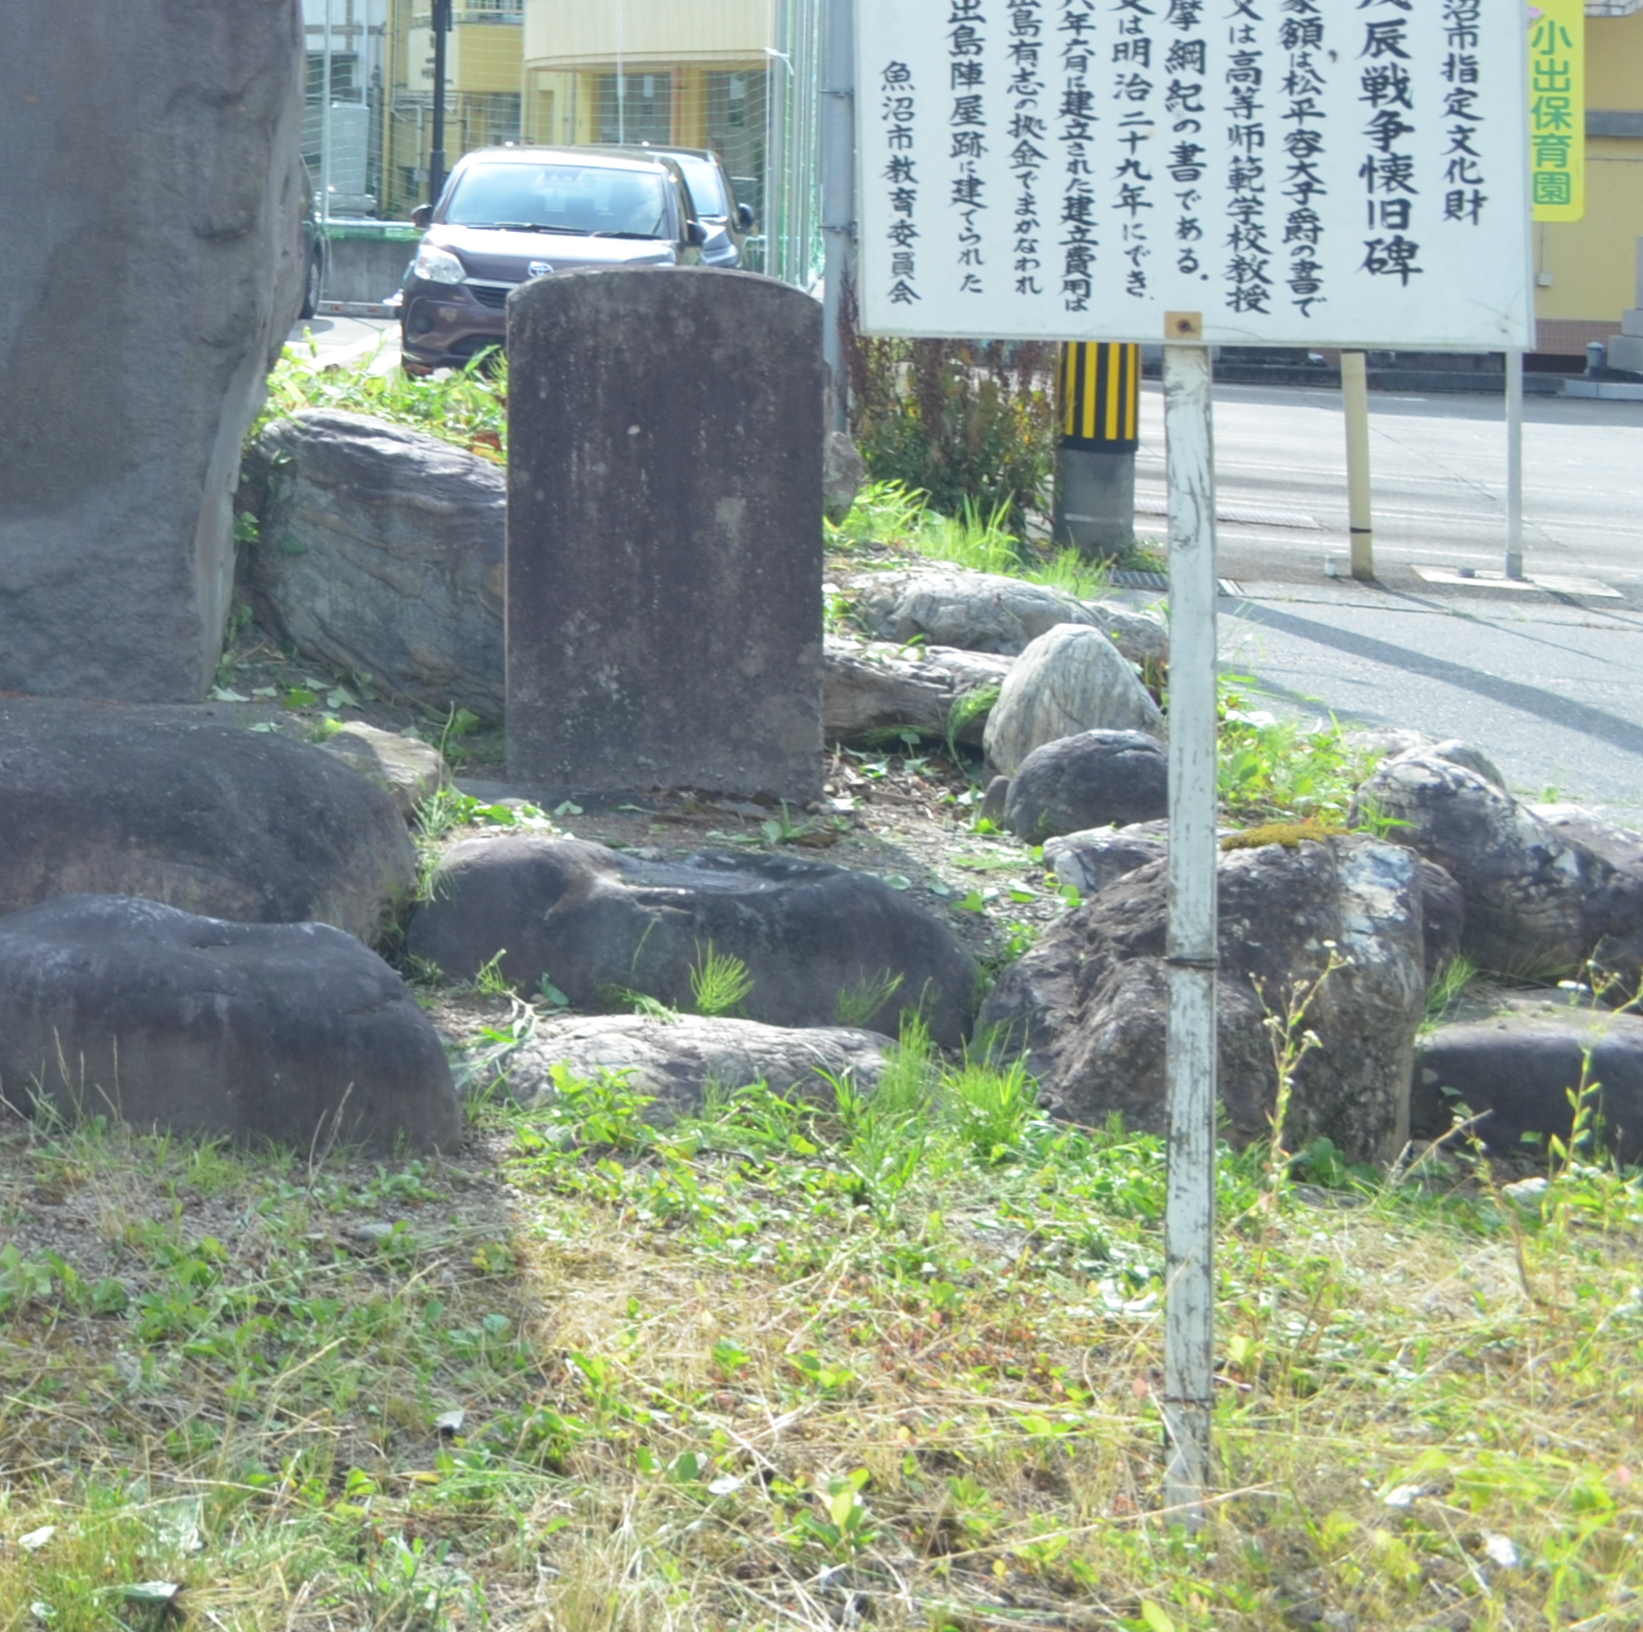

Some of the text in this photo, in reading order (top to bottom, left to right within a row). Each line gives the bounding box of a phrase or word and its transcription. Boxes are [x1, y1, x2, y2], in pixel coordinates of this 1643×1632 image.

[880, 60, 922, 305] 魚沼市教育委員会
[1531, 20, 1573, 205] 小出保育園
